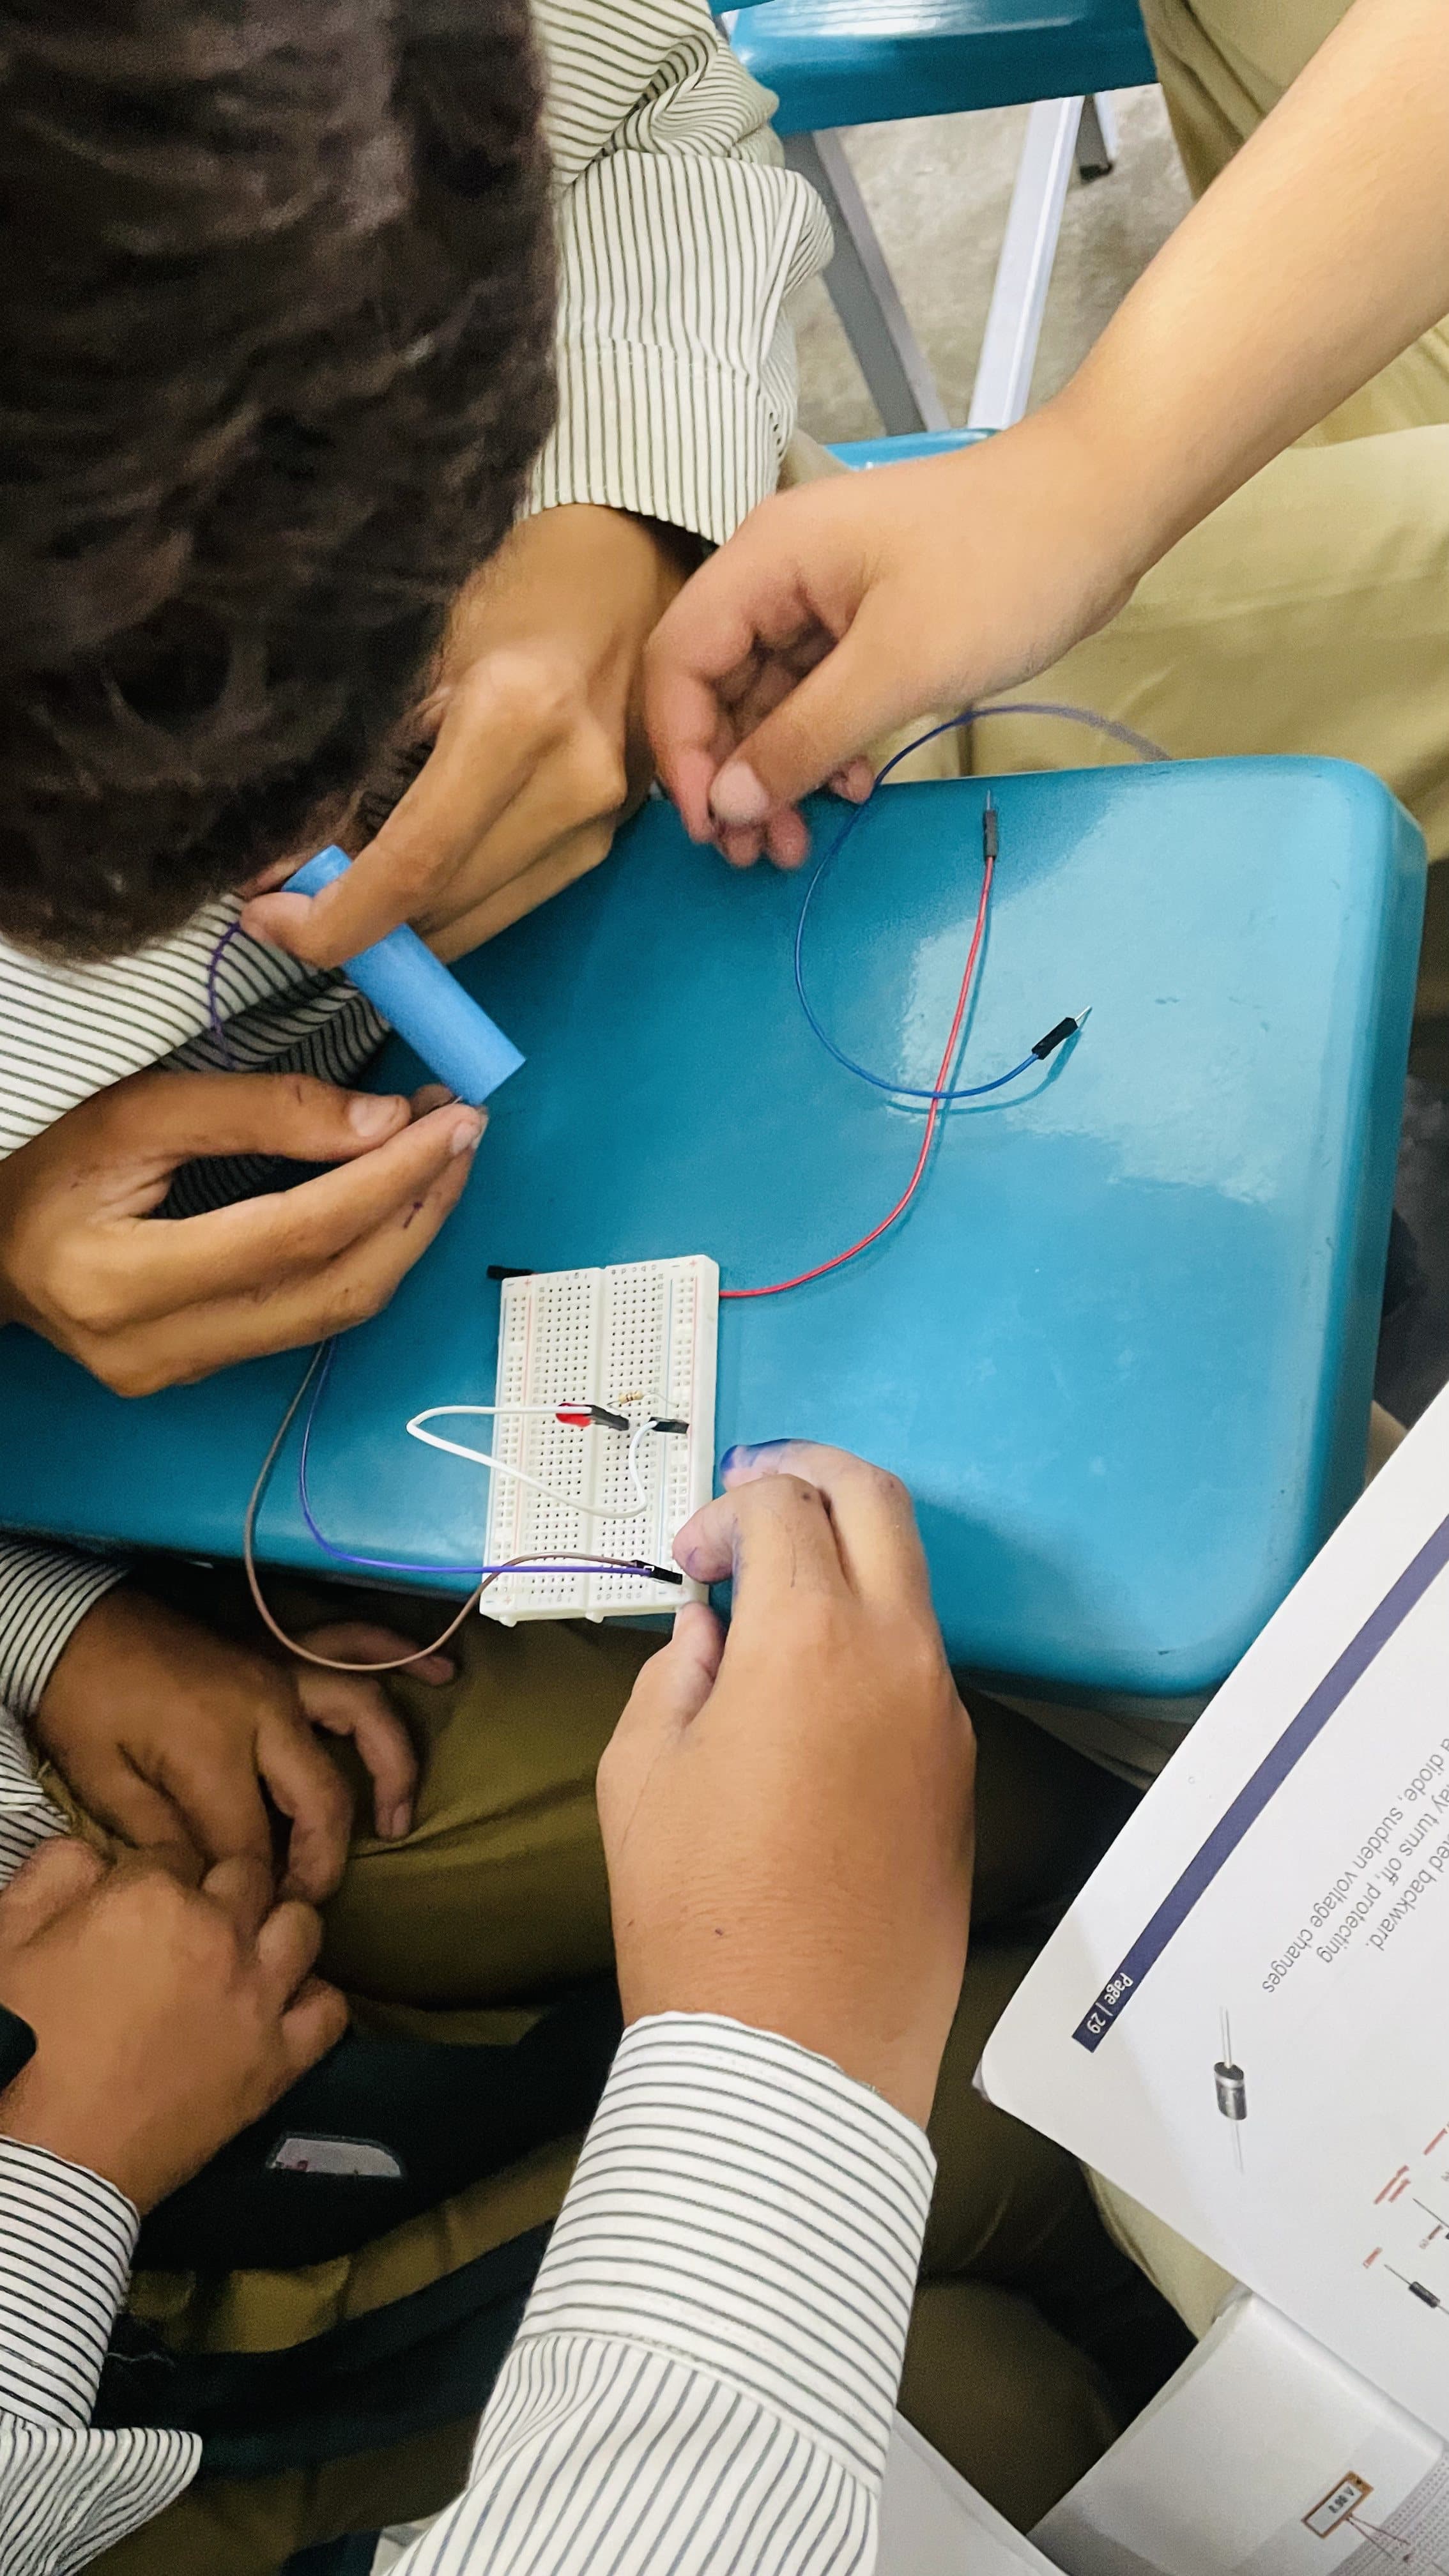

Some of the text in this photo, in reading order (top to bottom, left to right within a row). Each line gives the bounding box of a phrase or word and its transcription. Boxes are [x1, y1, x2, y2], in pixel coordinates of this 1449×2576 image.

[1397, 1754, 1445, 1802] diode,
[1353, 1807, 1404, 1869] sudden
[1310, 1871, 1358, 1928] voltage
[1316, 1784, 1449, 1963] ay turns off, protecting
[1365, 1869, 1438, 1951] backward.
[1104, 1972, 1133, 2005] Page
[1262, 1929, 1314, 1993] changes
[1087, 2012, 1106, 2034] 29
